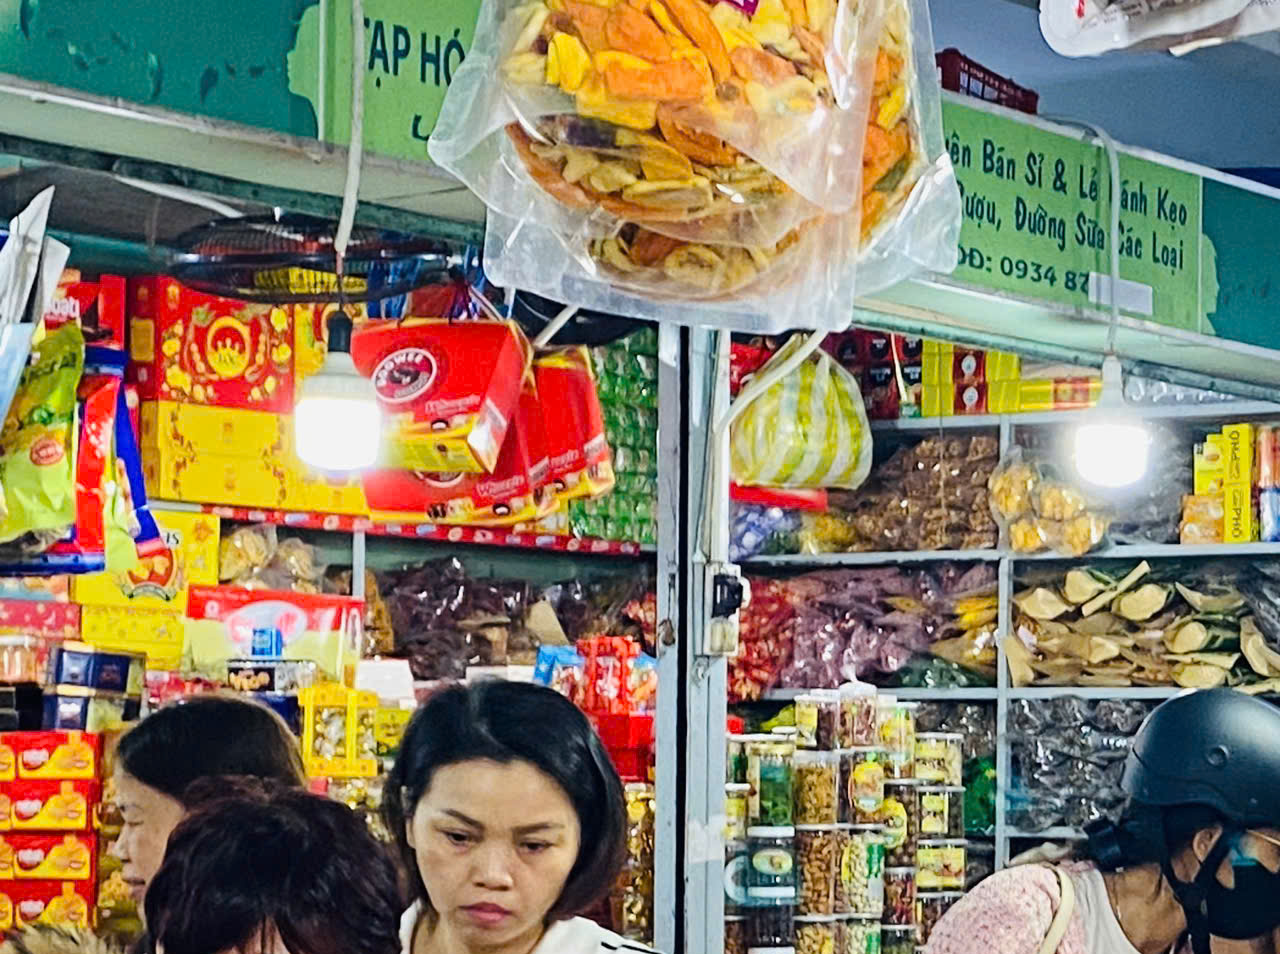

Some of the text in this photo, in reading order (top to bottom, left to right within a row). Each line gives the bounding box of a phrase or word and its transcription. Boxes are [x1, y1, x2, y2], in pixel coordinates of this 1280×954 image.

[363, 17, 411, 88] ẠP
[983, 139, 1016, 181] Bán
[1025, 151, 1044, 188] Sỉ
[1053, 158, 1067, 195] &
[1079, 165, 1098, 201] Lẻ
[1157, 186, 1188, 231] Kẹo
[1000, 256, 1057, 287] 0934
[1015, 196, 1066, 251] Đường
[1075, 211, 1105, 250] Sữa
[1152, 231, 1184, 275] Loại
